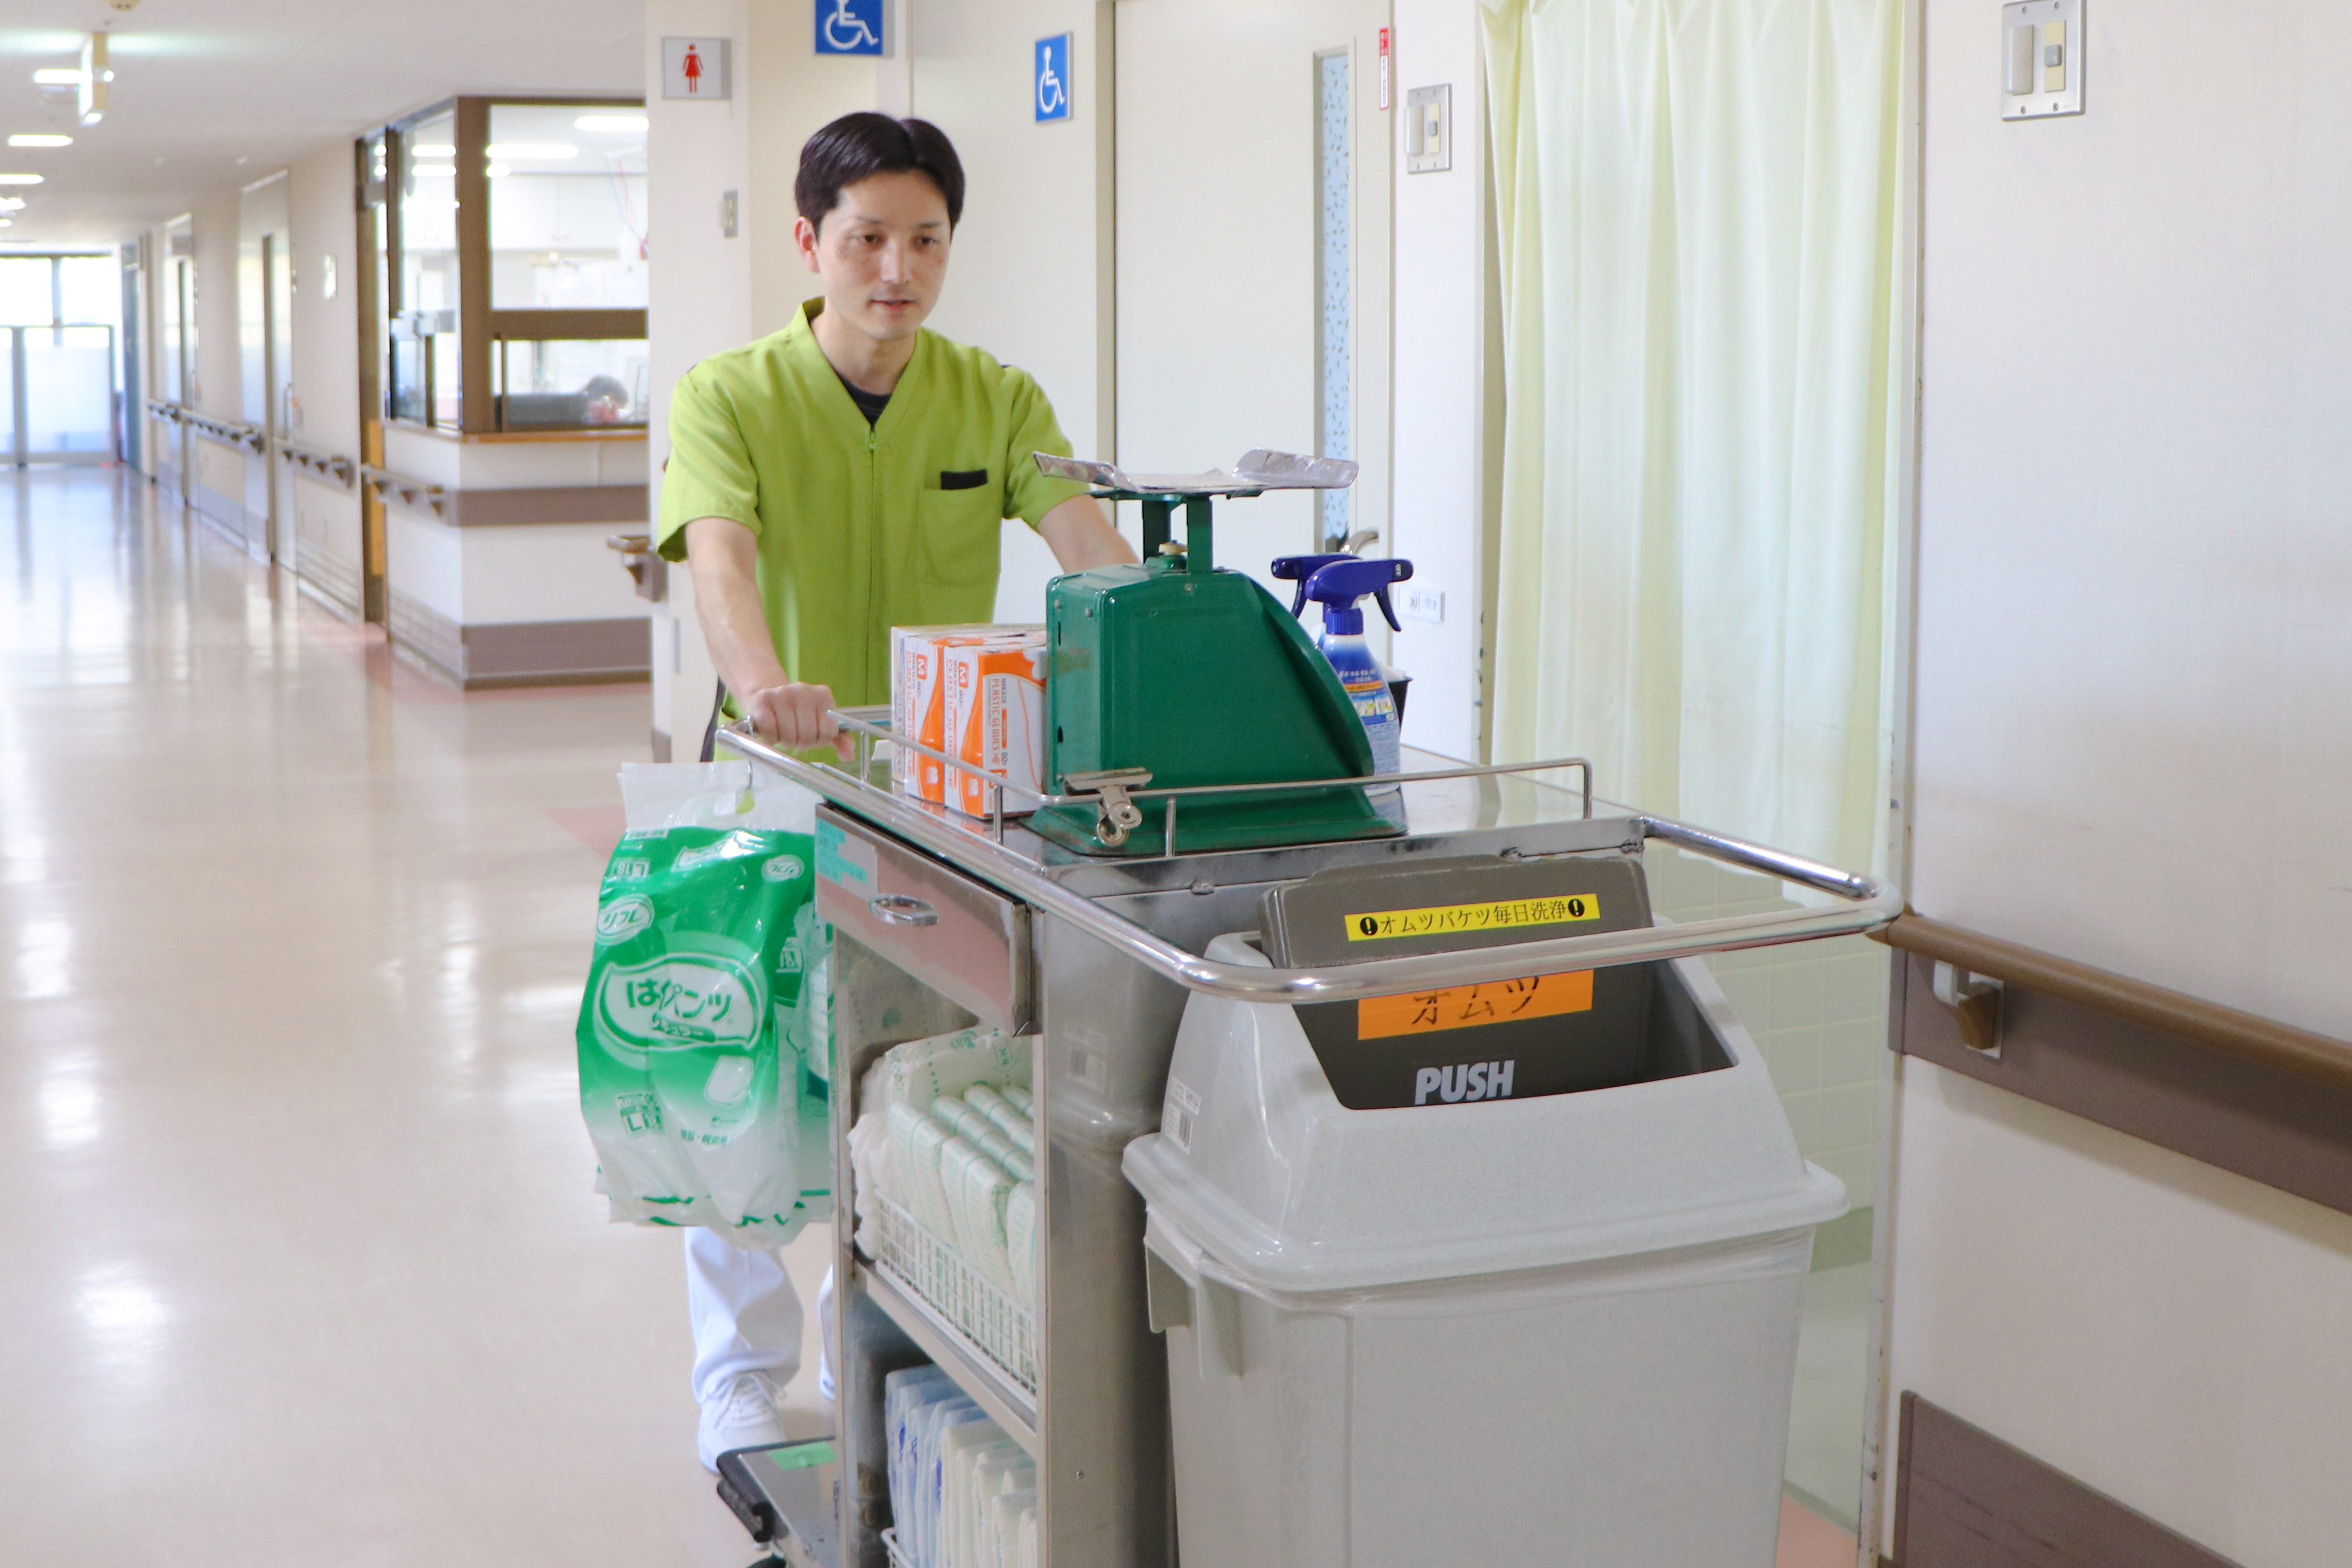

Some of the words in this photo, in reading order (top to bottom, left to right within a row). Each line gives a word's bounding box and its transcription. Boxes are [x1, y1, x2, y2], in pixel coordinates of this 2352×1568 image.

[917, 658, 926, 676] M
[959, 666, 968, 684] M
[992, 678, 1000, 715] PLASTIC
[636, 862, 645, 877] L
[604, 909, 645, 932] リフレ
[1411, 976, 1540, 1024] オムツ
[1415, 1060, 1515, 1106] PUSH
